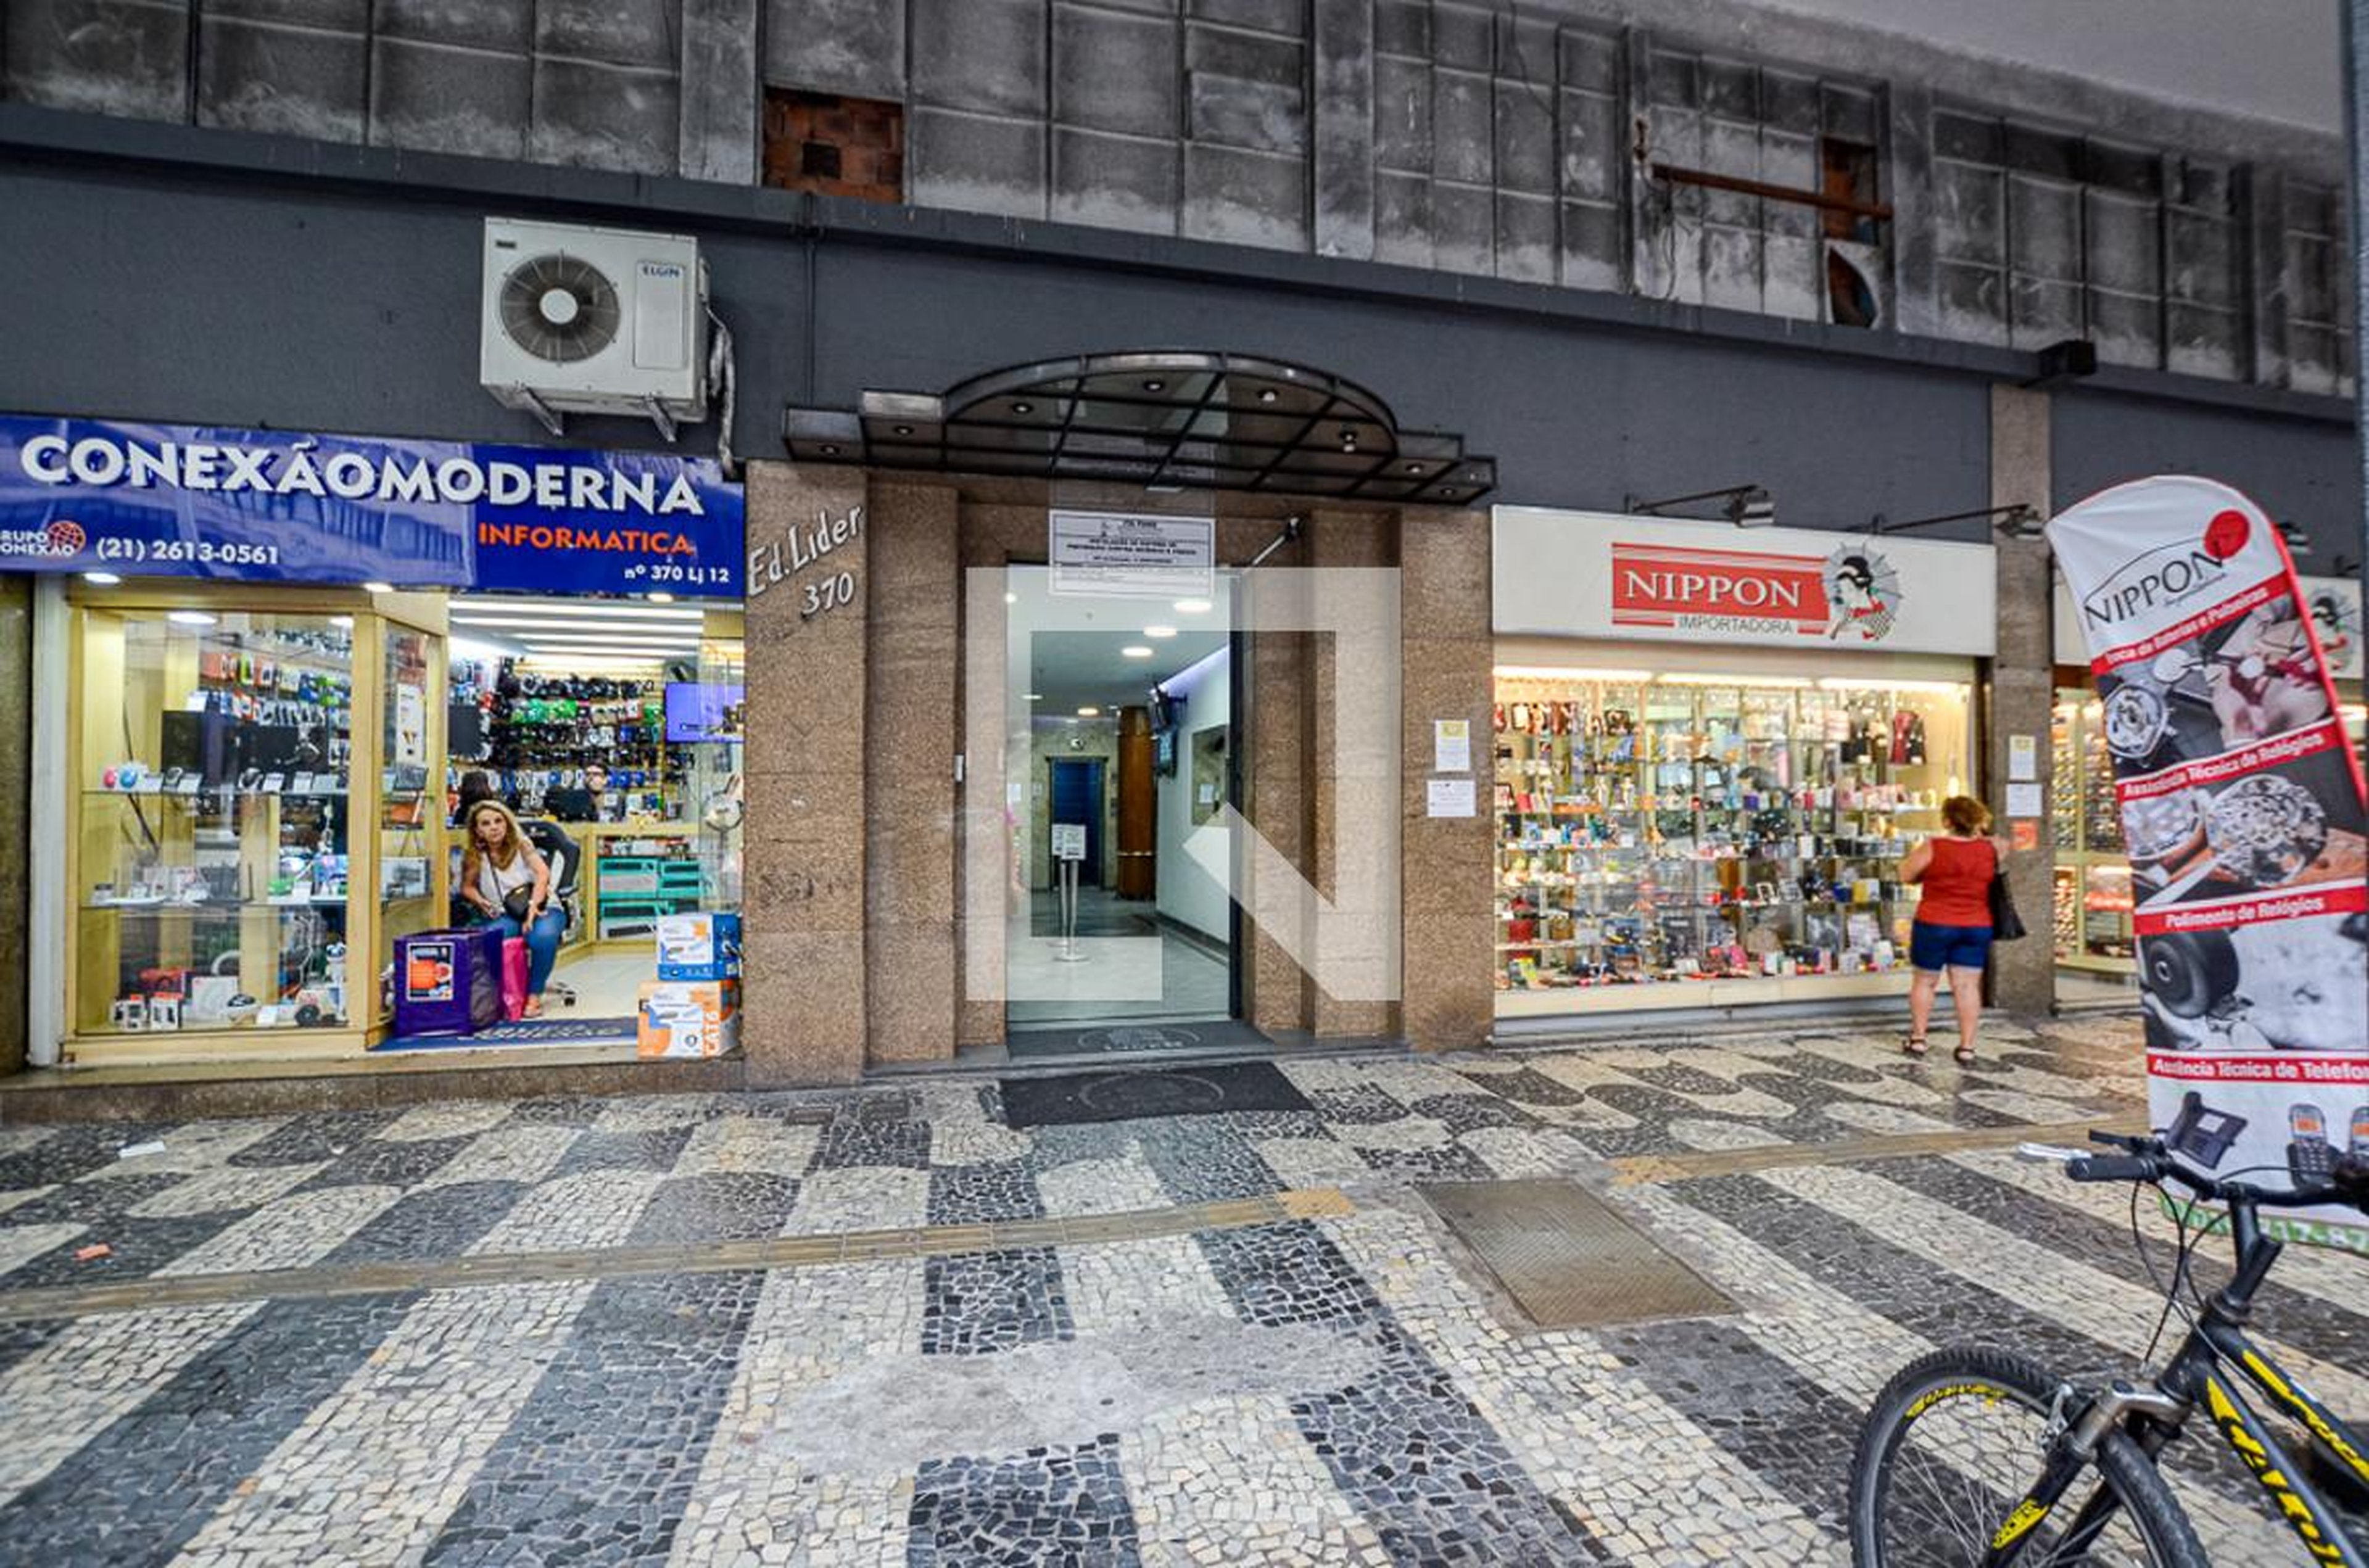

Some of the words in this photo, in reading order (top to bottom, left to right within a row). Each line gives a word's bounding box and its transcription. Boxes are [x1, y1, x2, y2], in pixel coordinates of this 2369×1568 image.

[96, 538, 145, 561] (21)
[154, 540, 279, 564] 2613-0561
[651, 566, 684, 581] 370
[710, 567, 730, 583] 12
[2083, 540, 2223, 631] NIPPON
[802, 572, 854, 616] 370
[1624, 570, 1800, 608] NIPPON
[1678, 615, 1792, 635] IMPORTADORA
[2237, 905, 2255, 920] de
[2275, 1061, 2297, 1078] de
